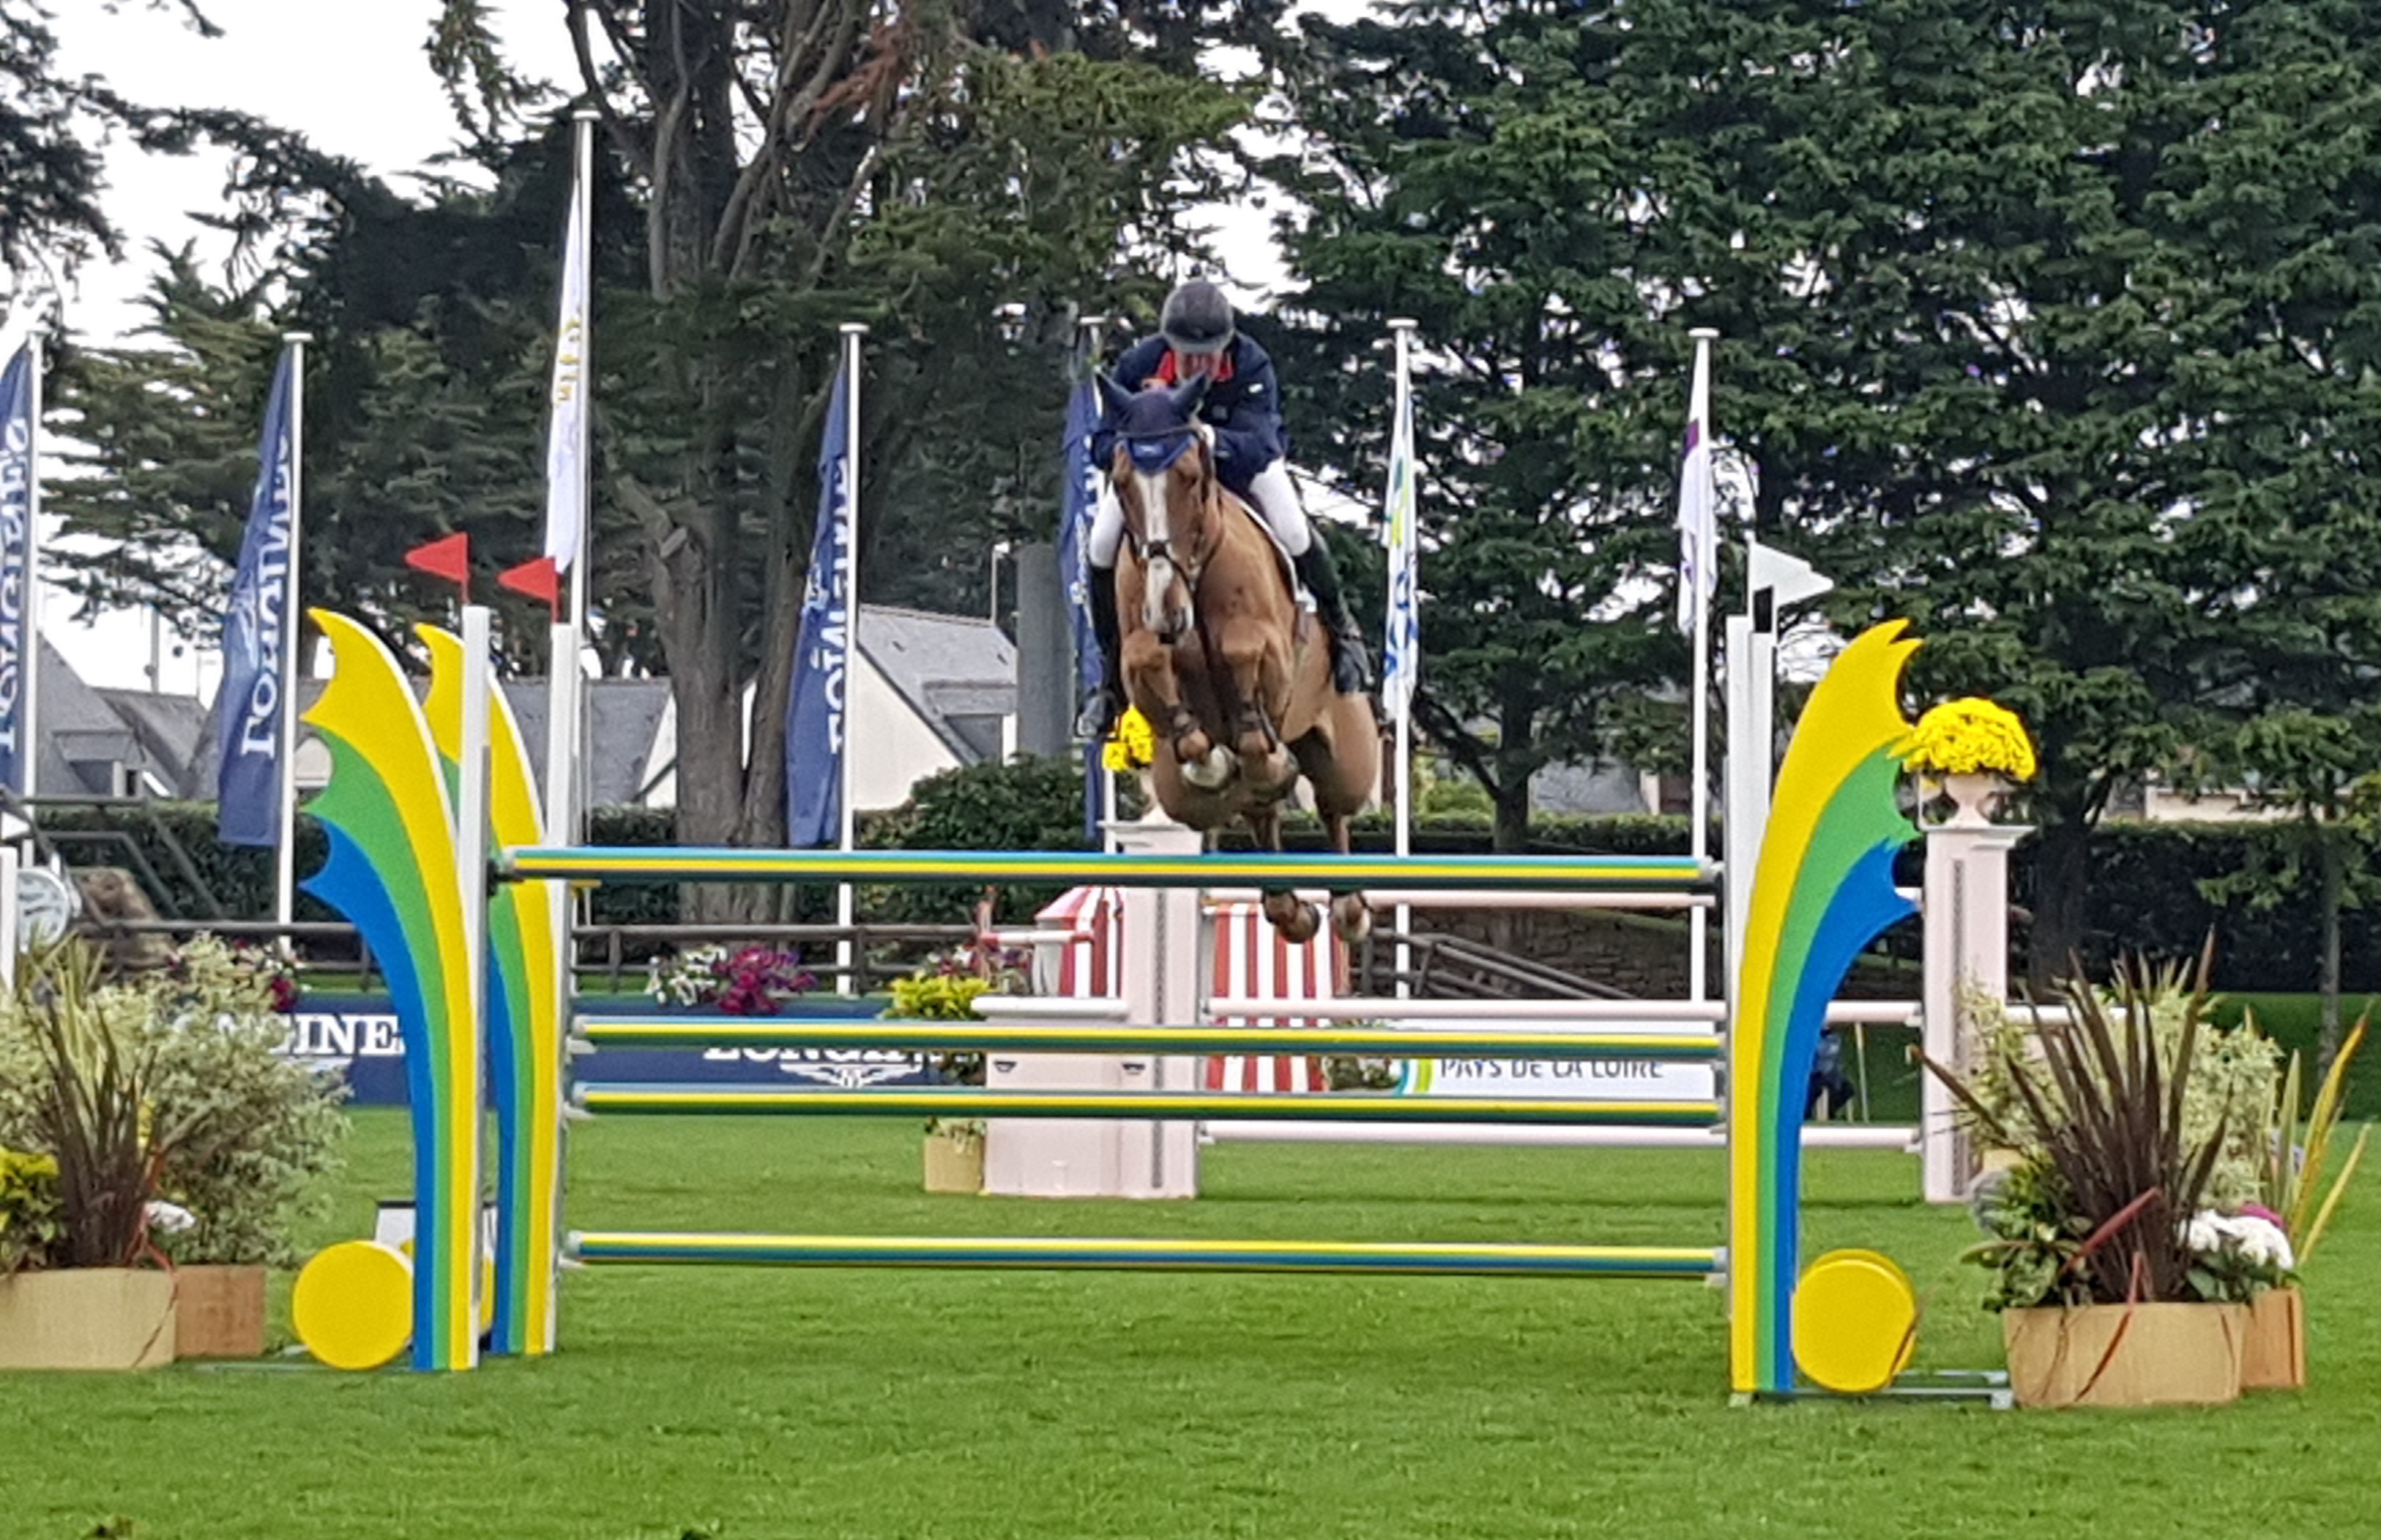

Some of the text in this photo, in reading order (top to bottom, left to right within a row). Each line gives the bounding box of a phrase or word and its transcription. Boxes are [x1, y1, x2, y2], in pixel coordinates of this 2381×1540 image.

[1441, 1059, 1663, 1078] PAYS DE LA LOIRE
